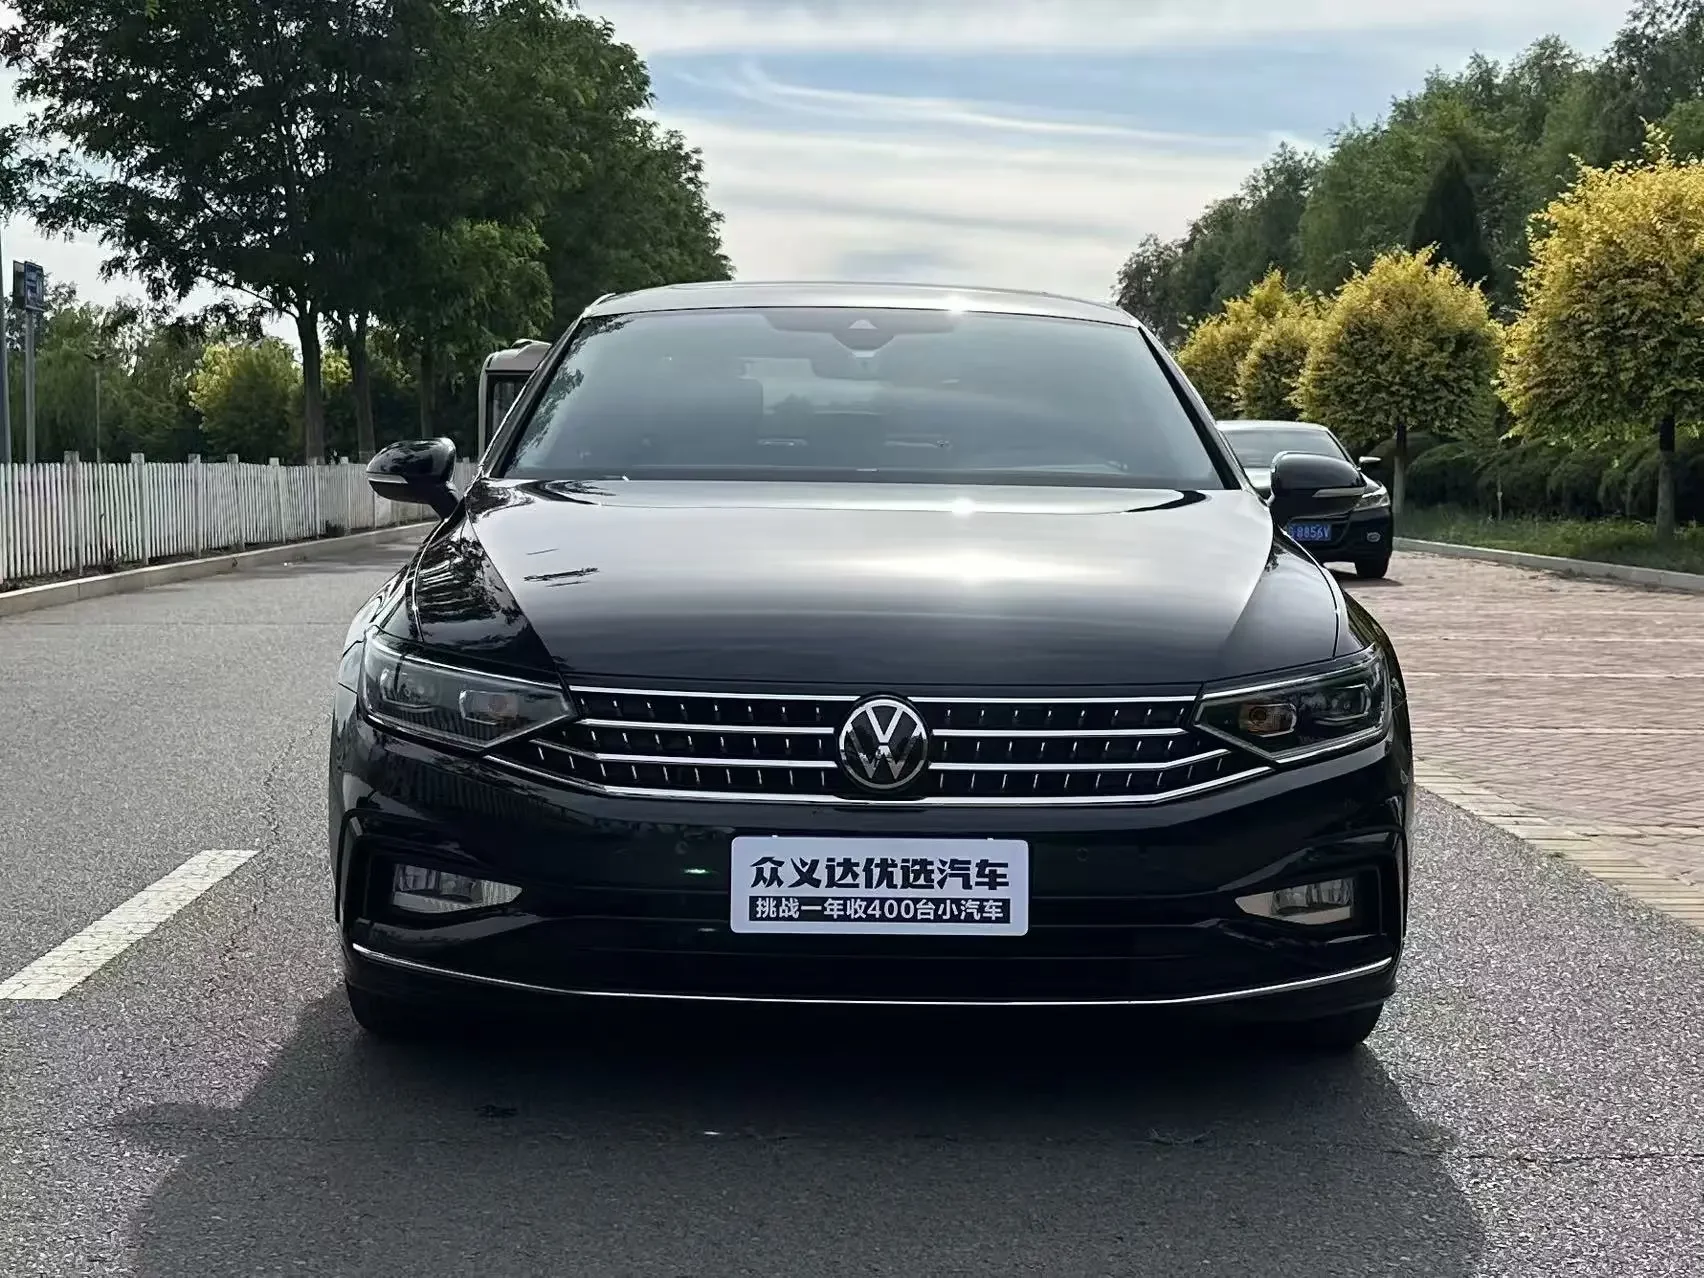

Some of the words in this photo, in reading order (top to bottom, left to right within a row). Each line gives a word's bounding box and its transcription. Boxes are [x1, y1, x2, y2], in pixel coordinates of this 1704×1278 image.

[749, 856, 1010, 891] 众义达优选汽车
[755, 897, 1004, 921] 挑战一年收400台小汽车
